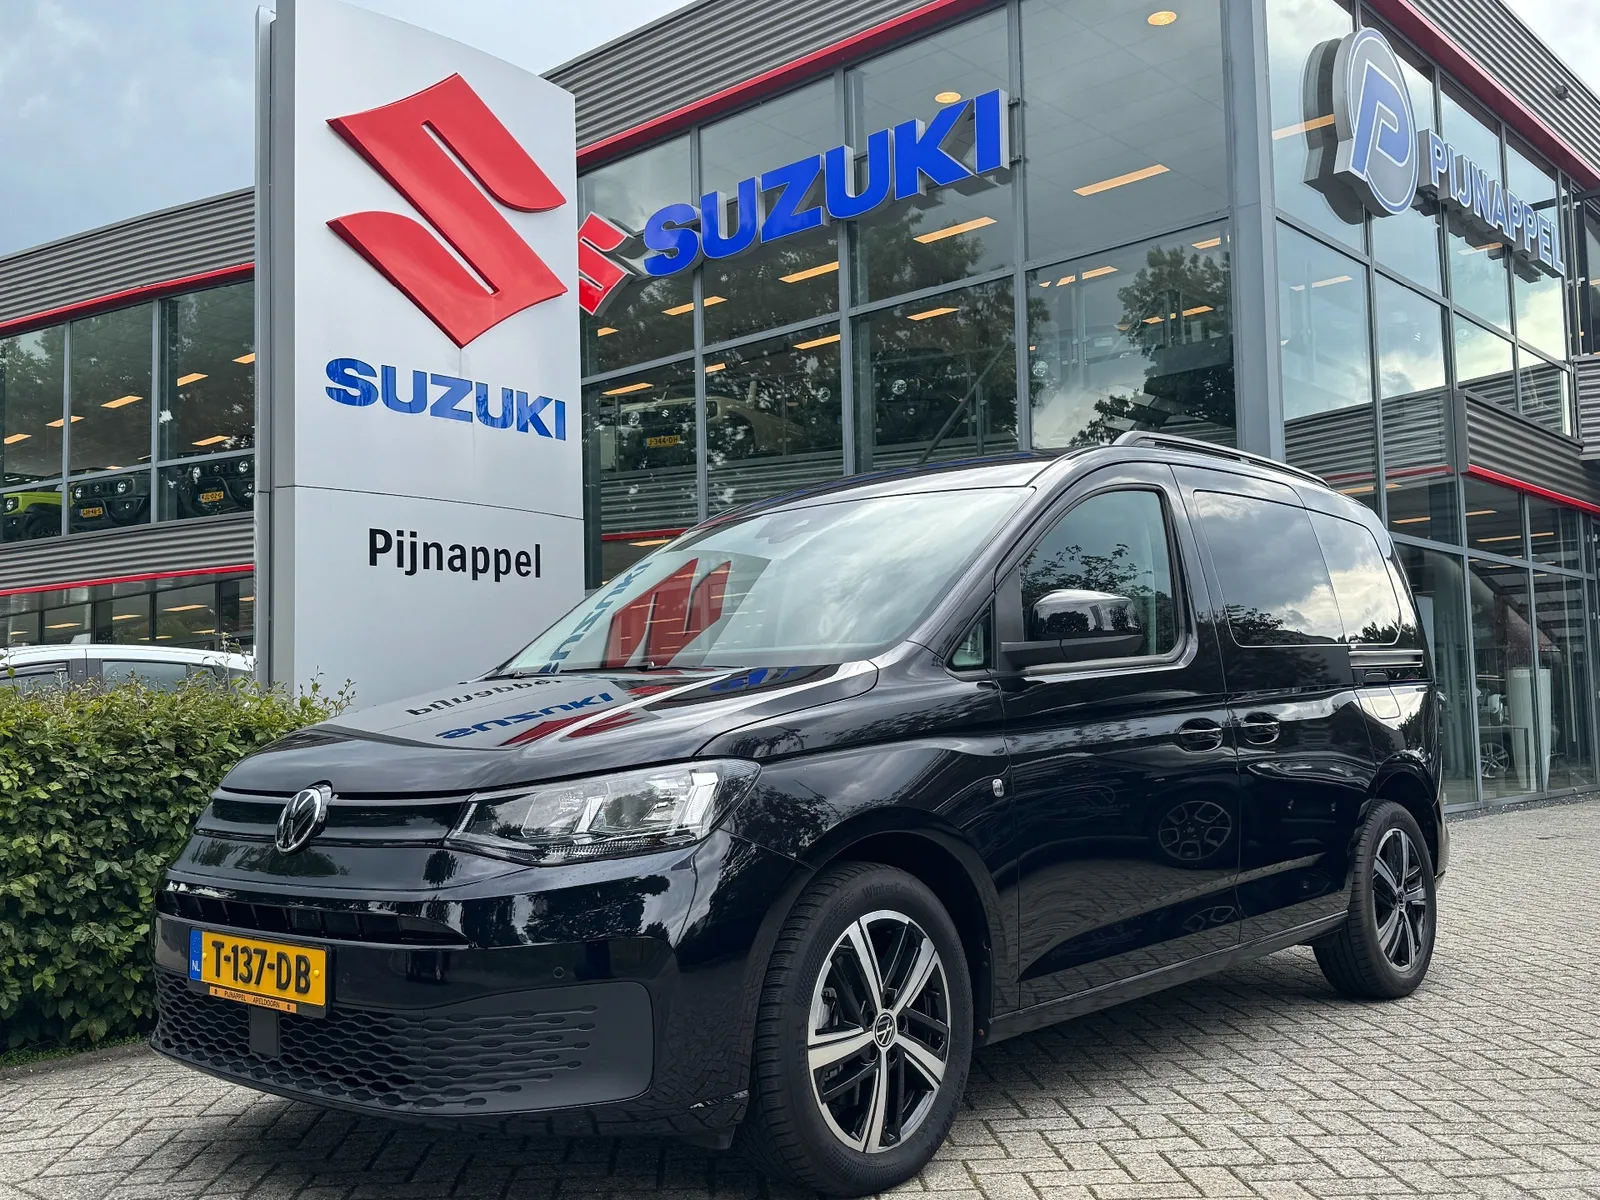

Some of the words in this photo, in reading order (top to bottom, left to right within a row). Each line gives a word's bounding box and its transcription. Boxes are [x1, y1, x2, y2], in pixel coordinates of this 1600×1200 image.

[643, 88, 1009, 277] SUZUKI
[1429, 129, 1564, 274] PIJNAPPEL
[325, 357, 567, 442] SUZUKI
[369, 528, 541, 583] Pijnappel
[191, 960, 200, 972] NL
[211, 940, 311, 994] T-137-DB
[224, 990, 247, 1002] PIJNAPPEL
[252, 996, 280, 1009] APELDOORN
